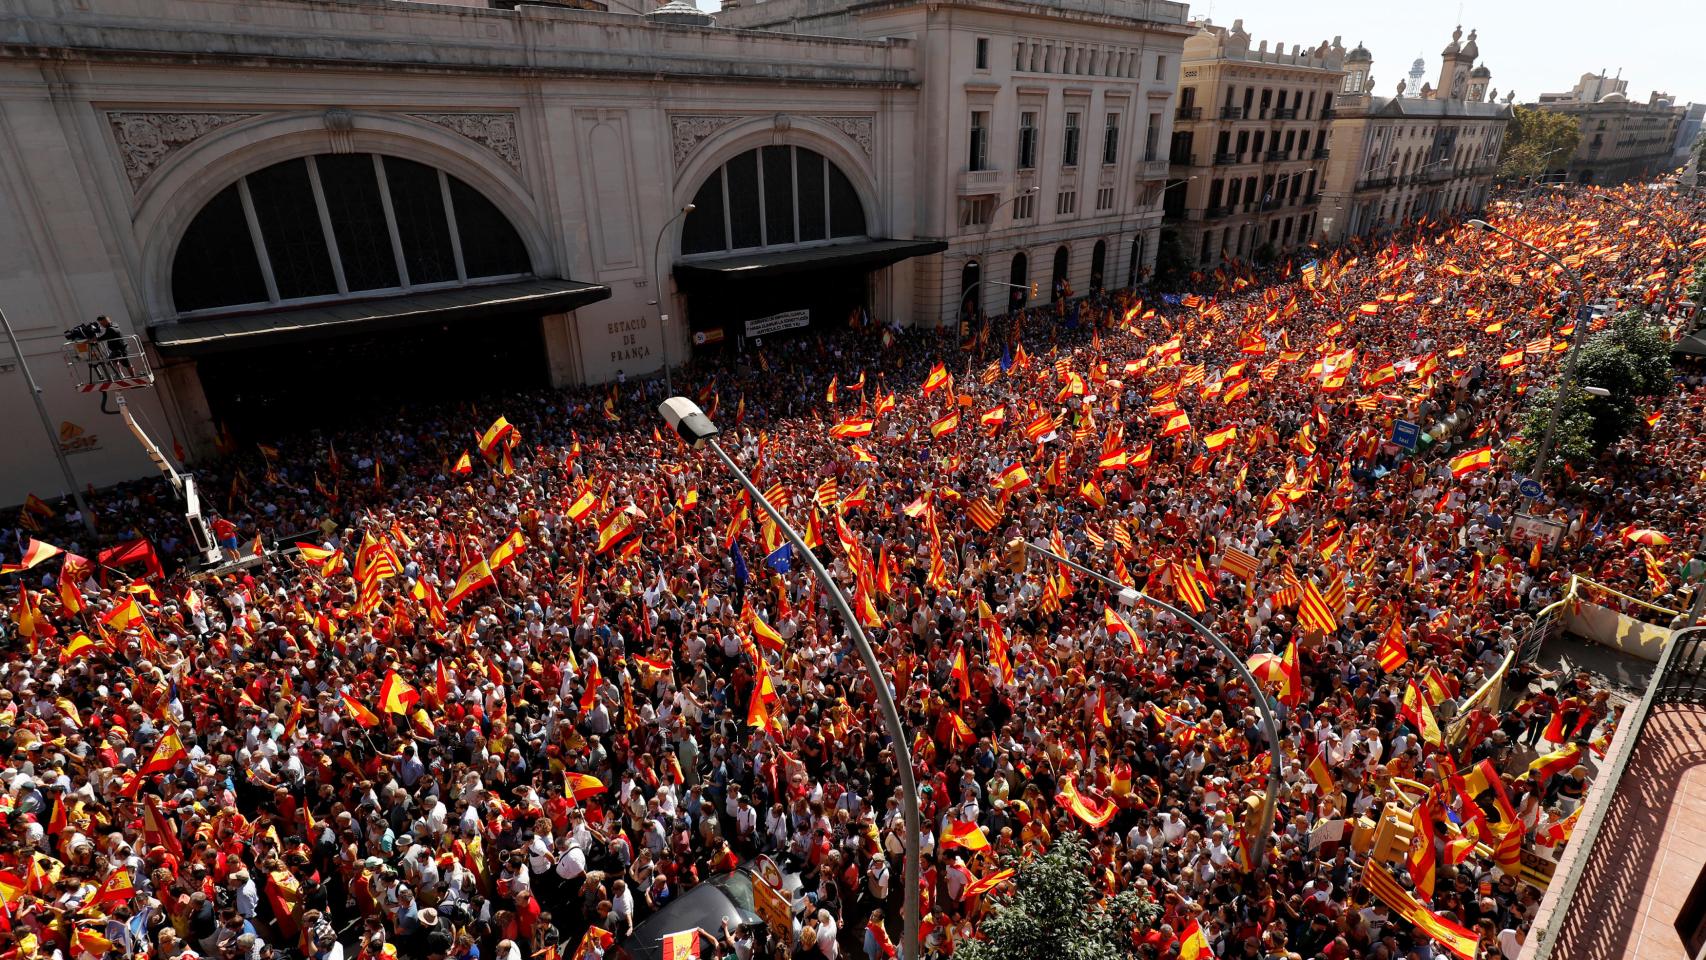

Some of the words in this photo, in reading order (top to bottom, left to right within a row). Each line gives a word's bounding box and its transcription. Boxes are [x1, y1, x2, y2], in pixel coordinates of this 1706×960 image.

[608, 316, 647, 334] ESTACIÓ
[623, 334, 636, 345] DE
[611, 346, 650, 362] FRANÇA
